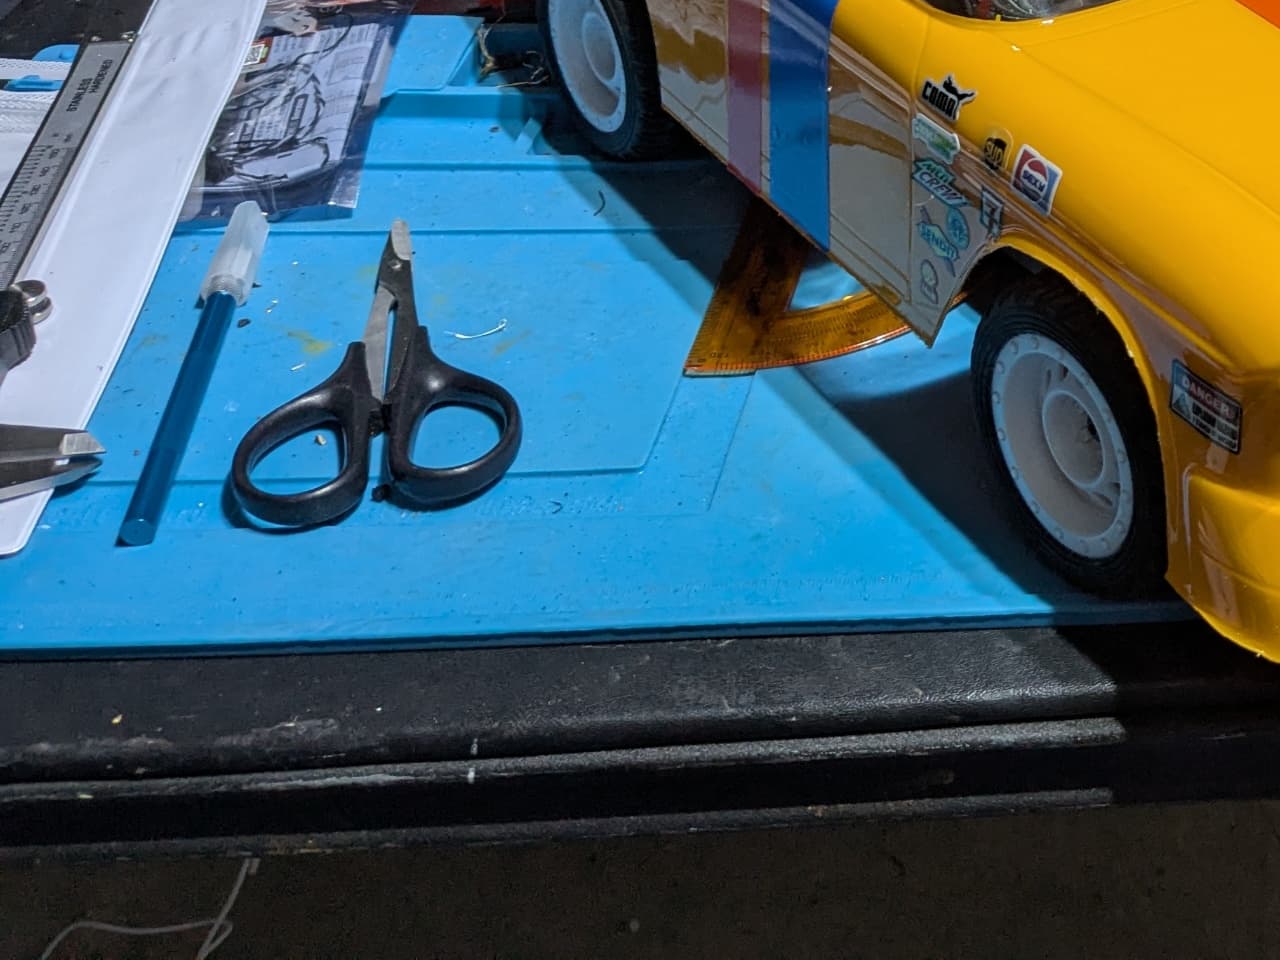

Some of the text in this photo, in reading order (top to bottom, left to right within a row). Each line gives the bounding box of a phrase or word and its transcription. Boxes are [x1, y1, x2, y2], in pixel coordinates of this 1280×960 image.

[66, 78, 93, 113] STAINLESS
[919, 171, 964, 202] CREW
[1021, 169, 1048, 197] SEXY
